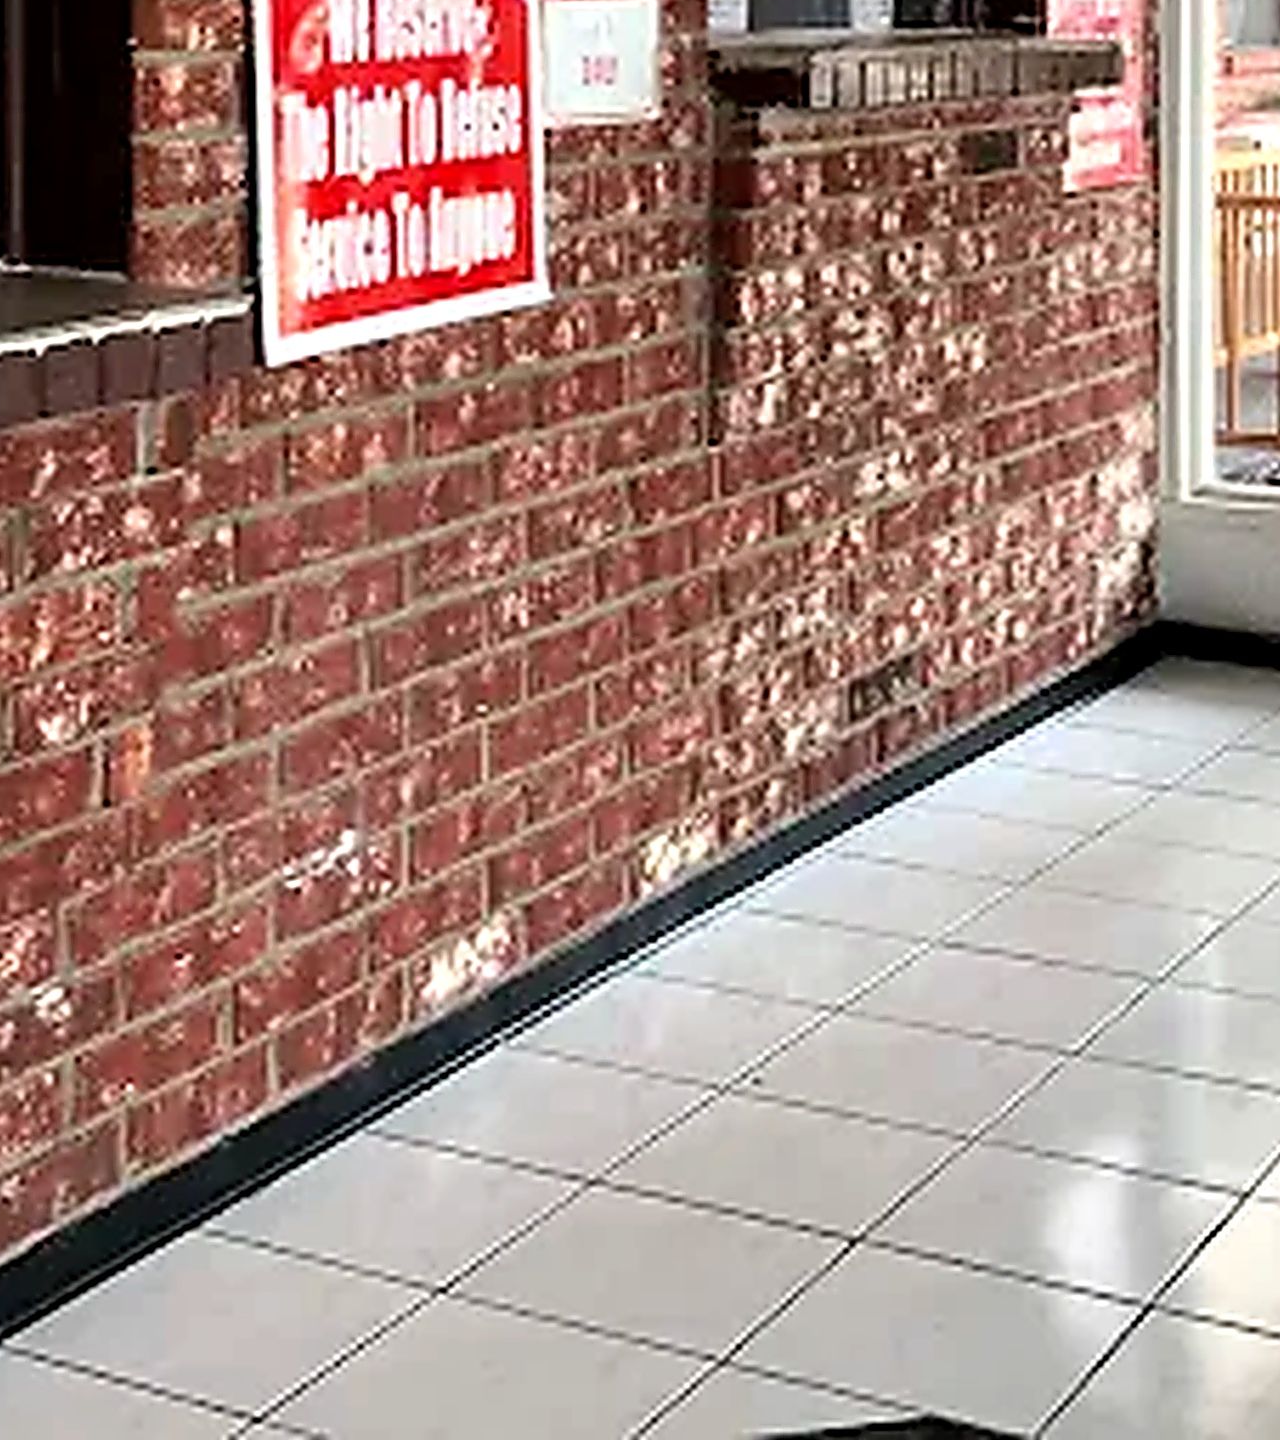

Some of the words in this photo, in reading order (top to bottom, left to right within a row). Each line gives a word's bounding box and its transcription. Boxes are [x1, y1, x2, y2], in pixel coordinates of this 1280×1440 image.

[280, 89, 329, 182] The
[335, 83, 403, 185] Right
[406, 80, 436, 166] To
[441, 77, 521, 162] Refuse
[293, 198, 390, 302] Service
[392, 191, 425, 278] To
[429, 186, 517, 277] Anyone
